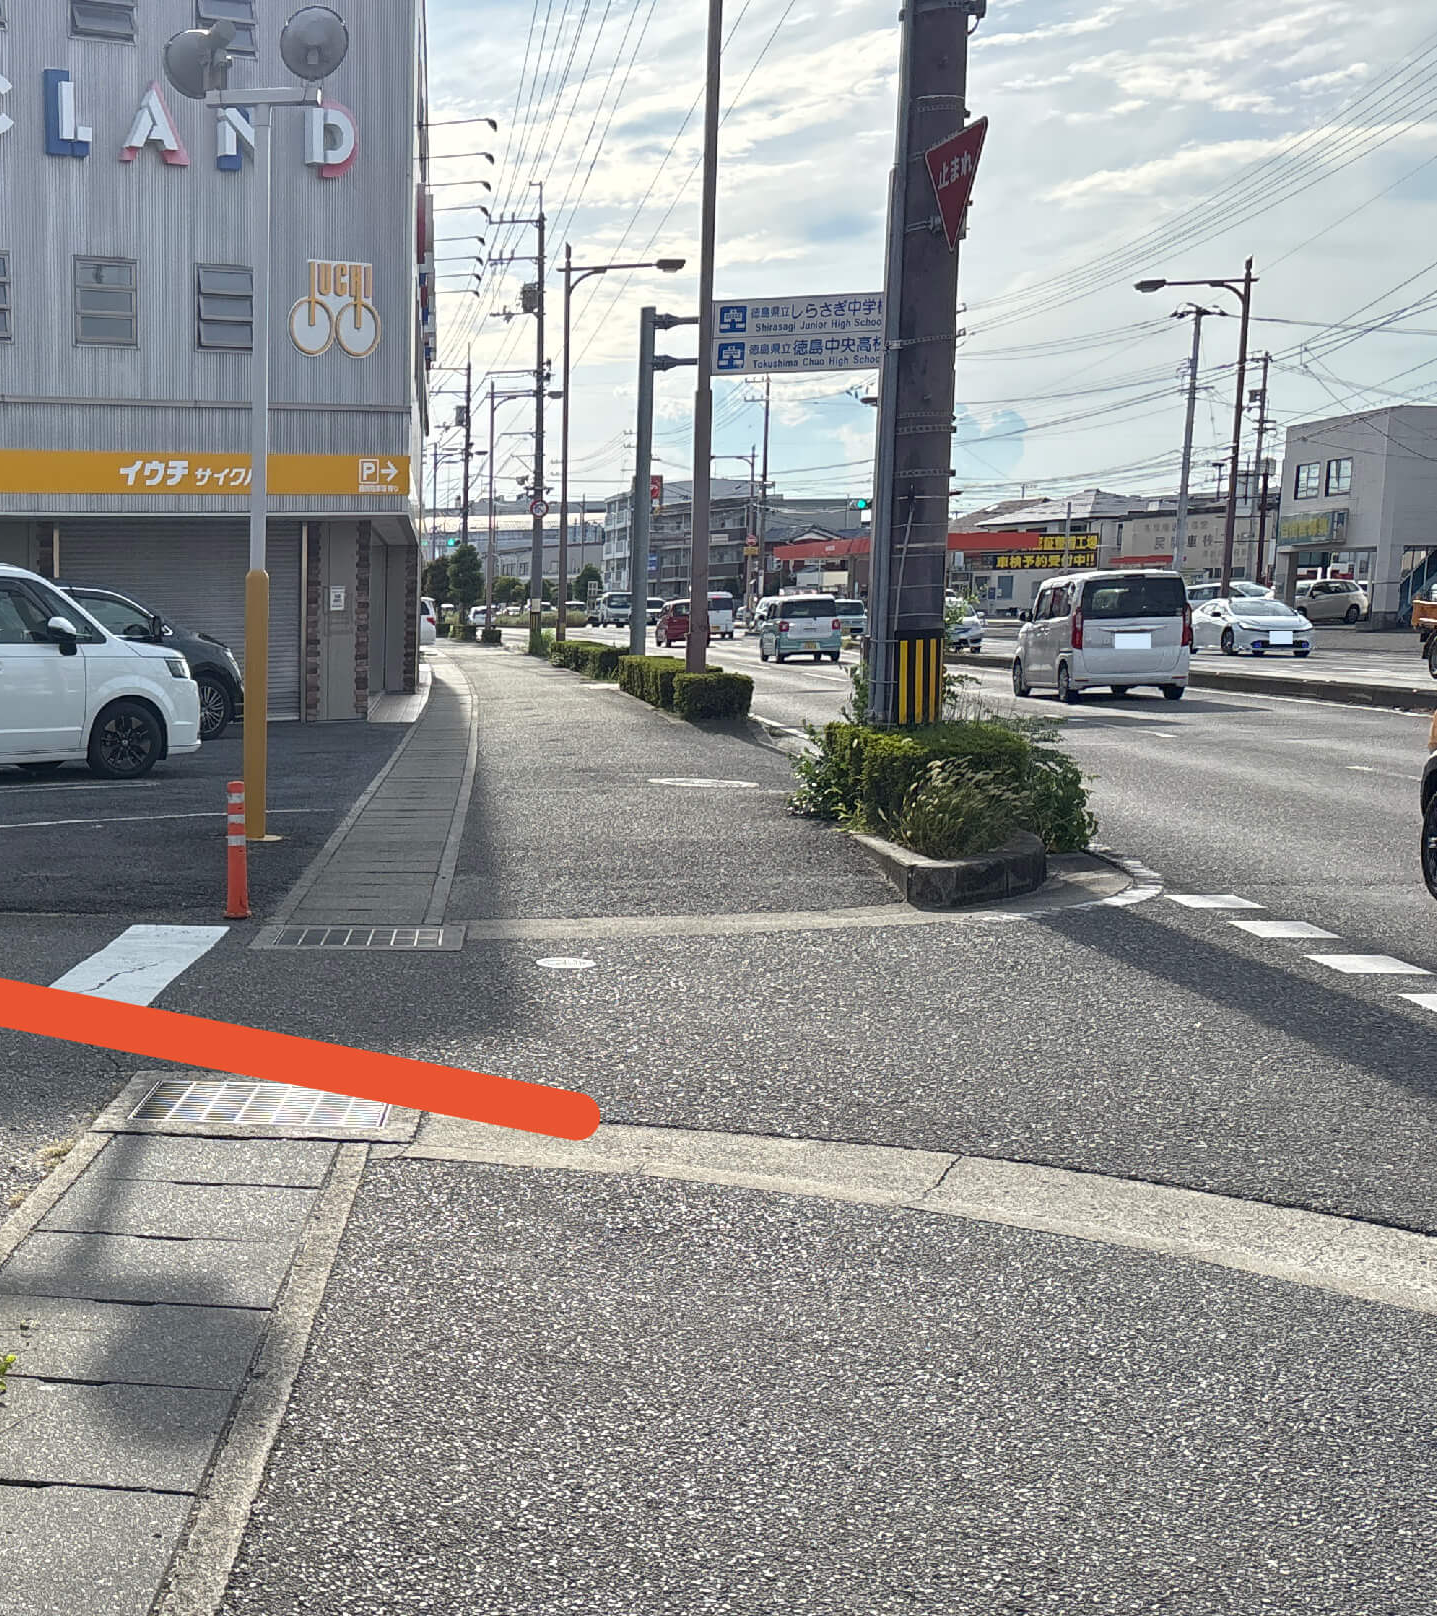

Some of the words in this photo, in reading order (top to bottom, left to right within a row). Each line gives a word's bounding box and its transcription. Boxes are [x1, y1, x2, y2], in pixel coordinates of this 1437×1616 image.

[938, 151, 972, 190] 止まれ
[755, 322, 796, 333] Shirasagi
[800, 320, 827, 331] Junior
[831, 319, 851, 330] High
[854, 317, 882, 328] Schoo
[753, 358, 799, 369] Tokushima
[802, 357, 825, 367] Chuo
[828, 356, 850, 367] High
[119, 460, 189, 486] イウチ
[362, 461, 376, 481] P
